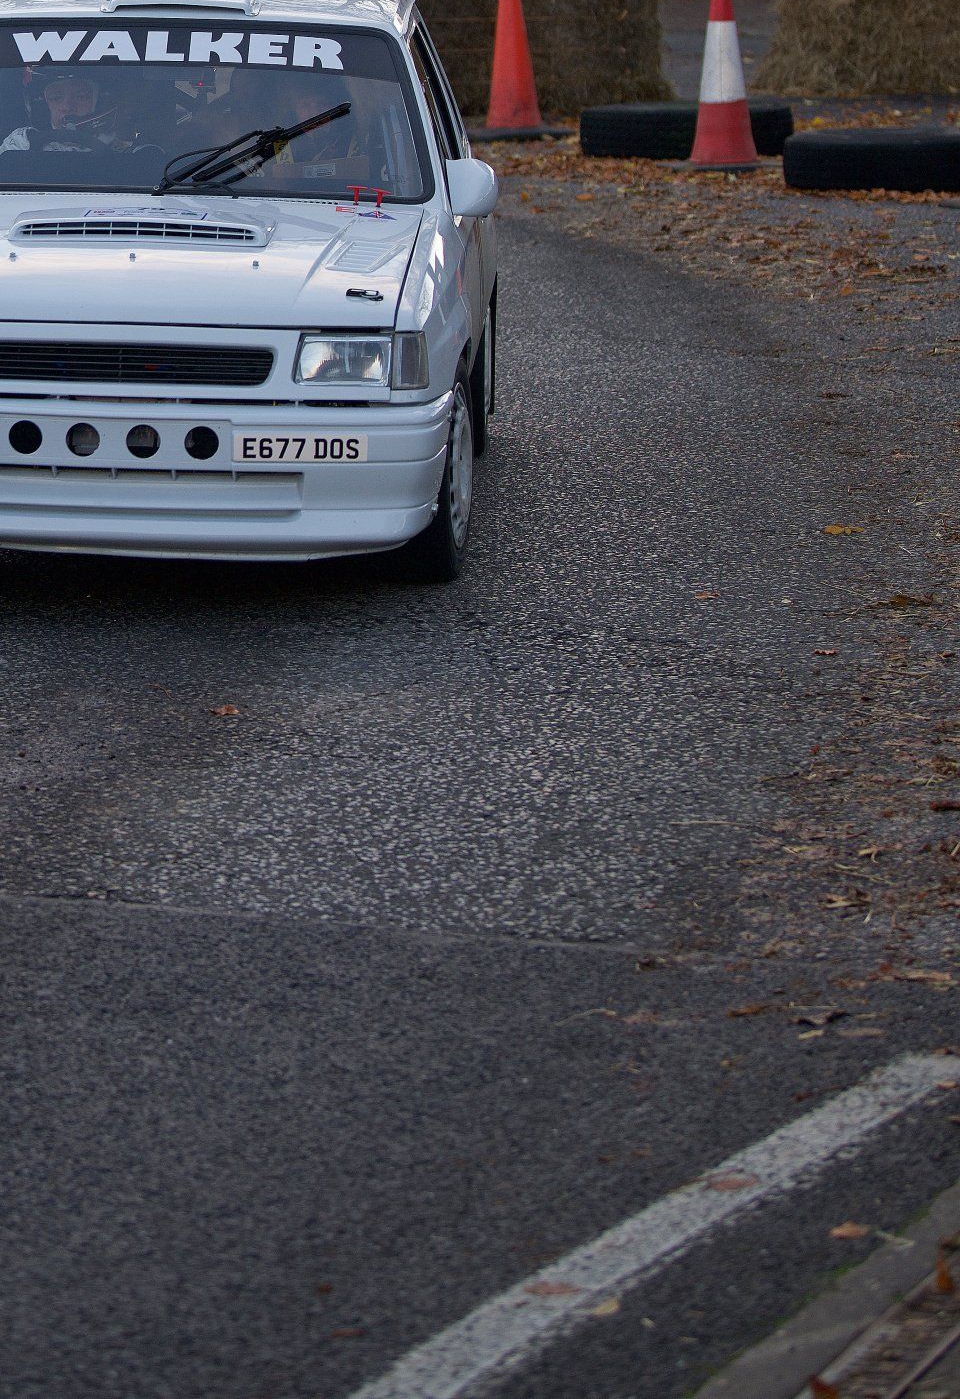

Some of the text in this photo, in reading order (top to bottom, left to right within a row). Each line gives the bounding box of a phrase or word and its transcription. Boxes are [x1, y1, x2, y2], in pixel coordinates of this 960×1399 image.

[12, 30, 344, 70] WALKER
[242, 437, 359, 459] E677 DOS
